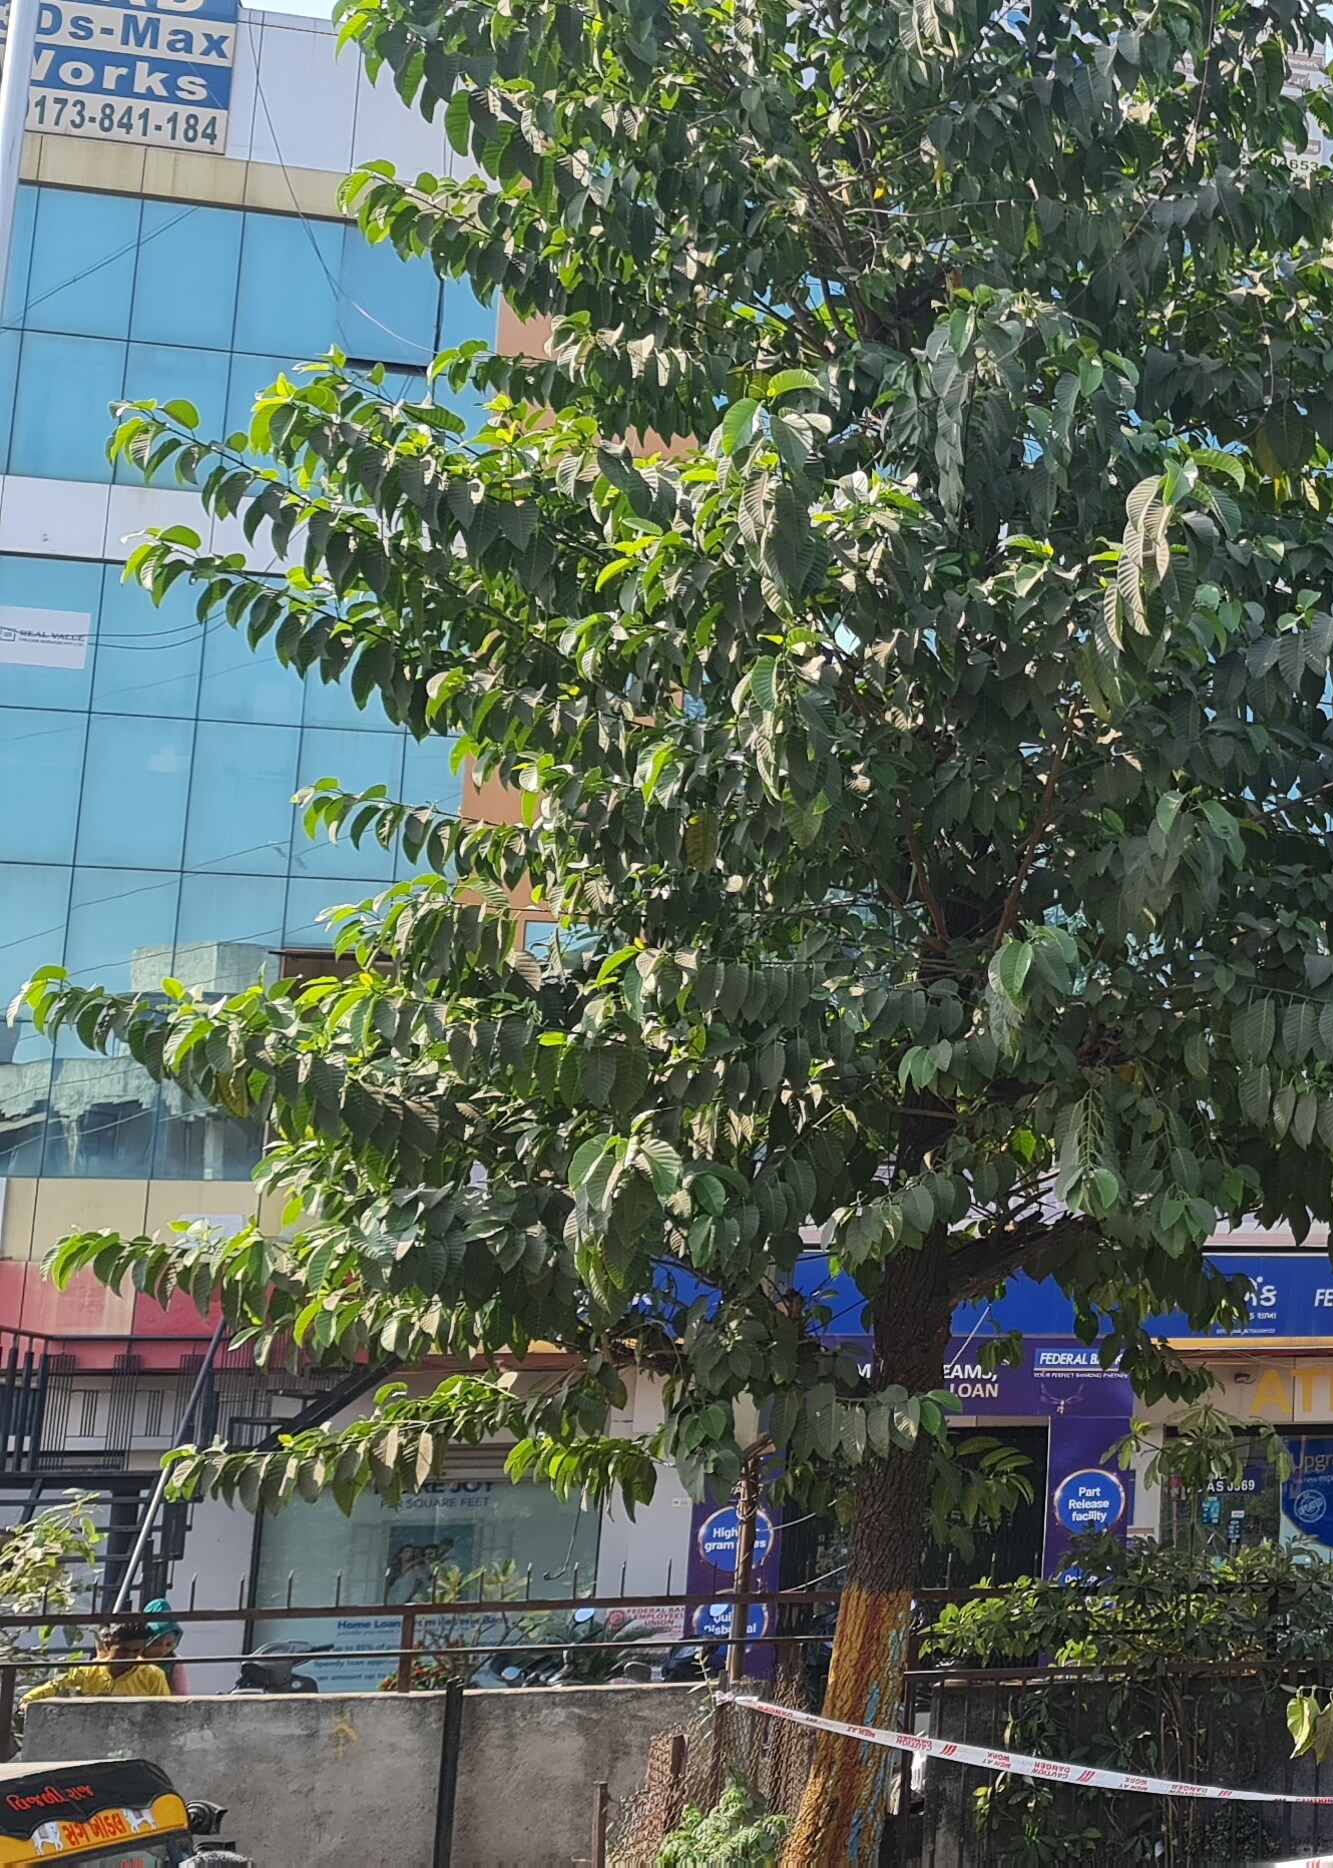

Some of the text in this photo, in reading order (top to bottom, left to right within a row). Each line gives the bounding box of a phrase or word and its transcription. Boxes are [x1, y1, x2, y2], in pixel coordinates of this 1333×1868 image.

[27, 94, 218, 146] 173-841-184
[1040, 1353, 1089, 1365] FEDERAL
[1078, 1486, 1101, 1497] Part
[405, 1498, 457, 1509] SQUARE
[460, 1496, 491, 1507] FEET
[1068, 1499, 1110, 1509] Release
[1072, 1510, 1107, 1522] facility
[704, 1541, 734, 1552] gram
[338, 1620, 370, 1630] Home
